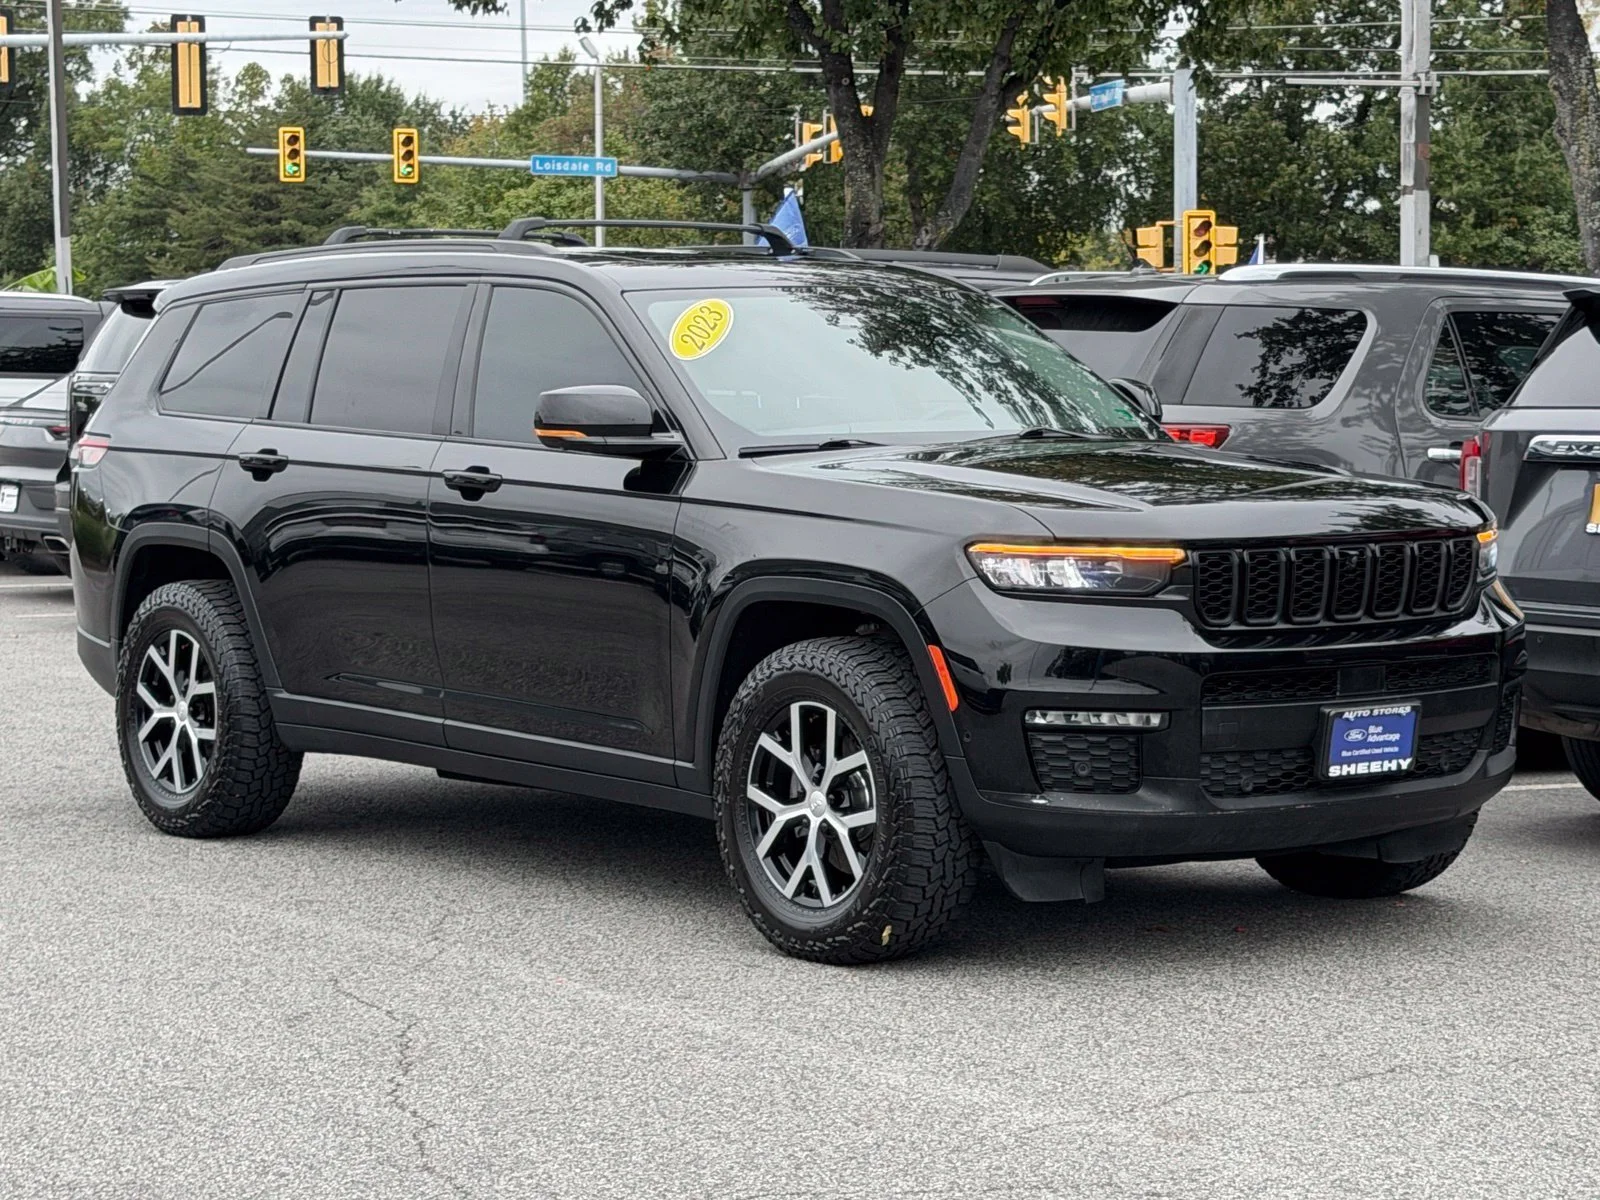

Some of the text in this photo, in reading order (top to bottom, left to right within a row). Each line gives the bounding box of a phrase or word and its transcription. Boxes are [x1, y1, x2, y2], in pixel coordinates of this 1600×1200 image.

[535, 160, 612, 172] Loisdale Rd
[680, 306, 723, 351] 2023
[1342, 705, 1411, 721] AUTO STORES
[1368, 725, 1383, 734] Blue
[1367, 733, 1400, 742] Advantage
[1328, 757, 1412, 777] SHEEHY
